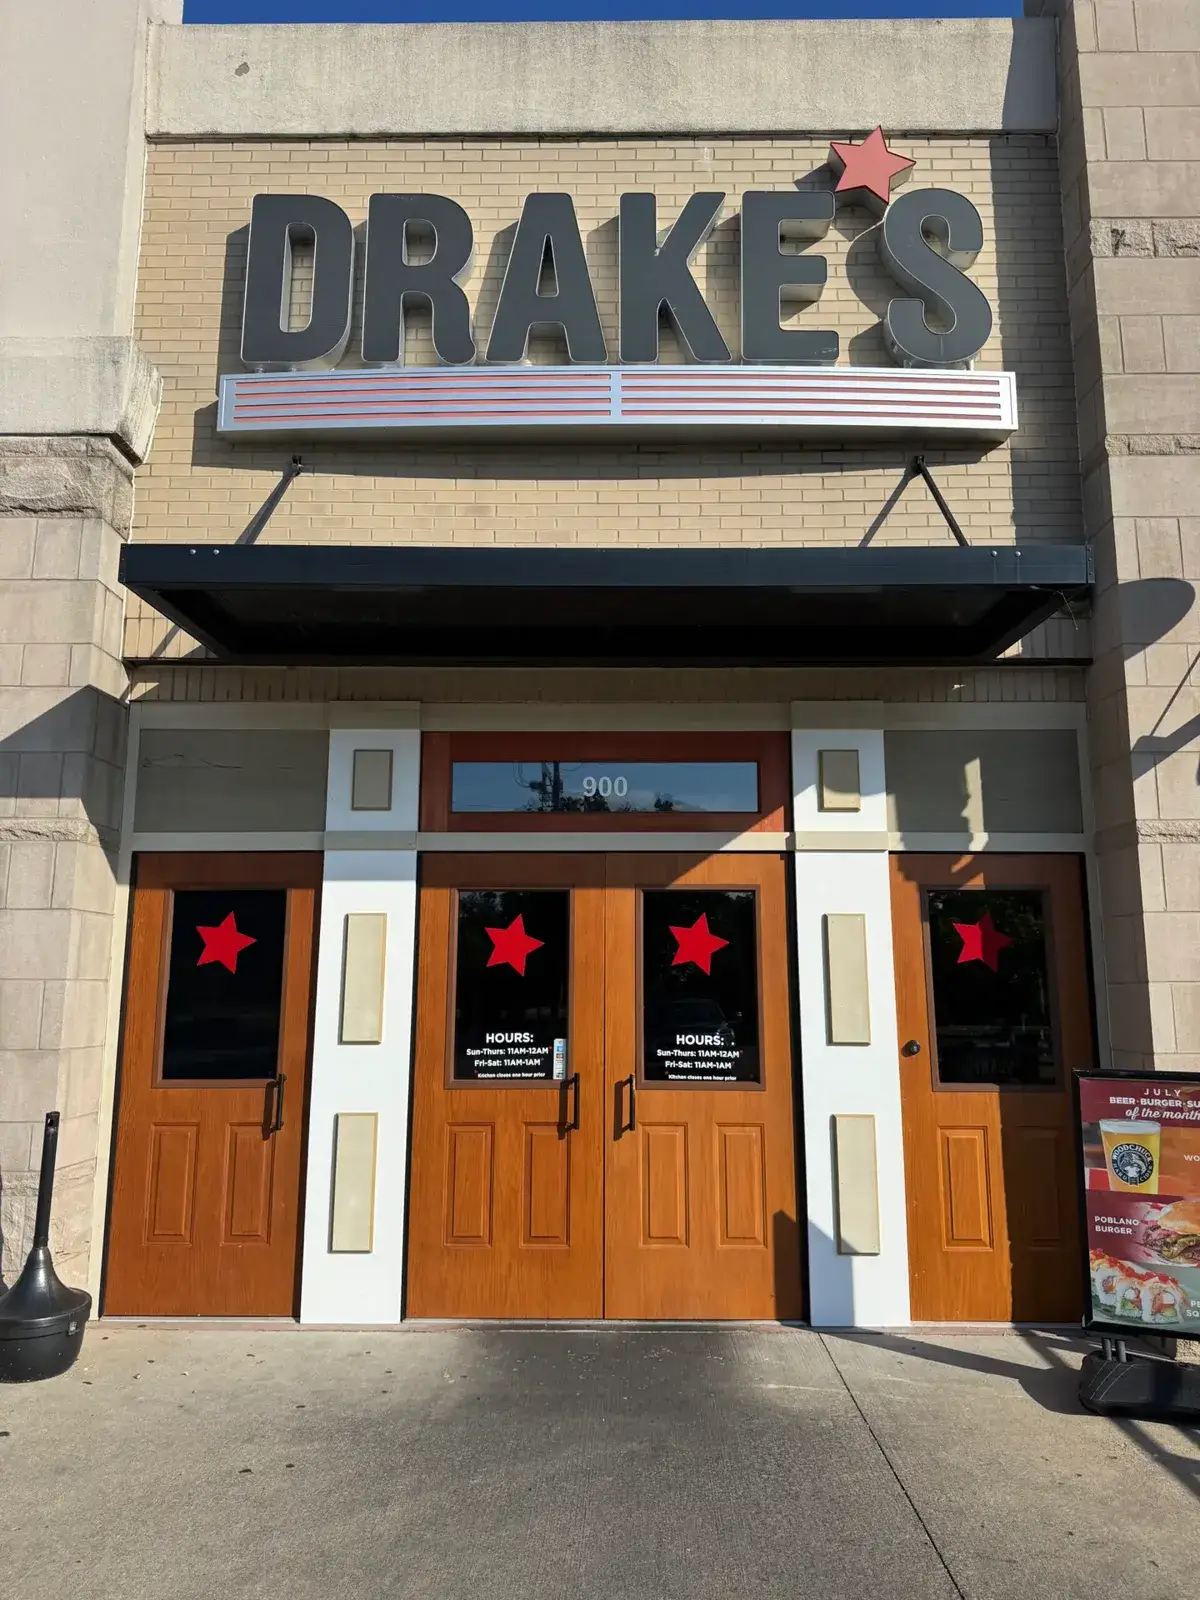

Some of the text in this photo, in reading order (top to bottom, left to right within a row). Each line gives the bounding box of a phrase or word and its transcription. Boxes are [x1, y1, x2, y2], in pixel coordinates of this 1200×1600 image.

[583, 776, 628, 797] 900
[486, 1033, 534, 1043] HOURS:
[676, 1034, 724, 1046] HOURS:
[466, 1048, 505, 1056] Sun-Thurs:
[657, 1049, 696, 1057] Sun-Thurs:
[474, 1059, 502, 1067] Fri-Sat:
[665, 1060, 693, 1068] Fri-Sat:
[1125, 1106, 1200, 1120] of the month
[1094, 1215, 1140, 1226] POBLANO
[1095, 1225, 1132, 1235] BURGER
